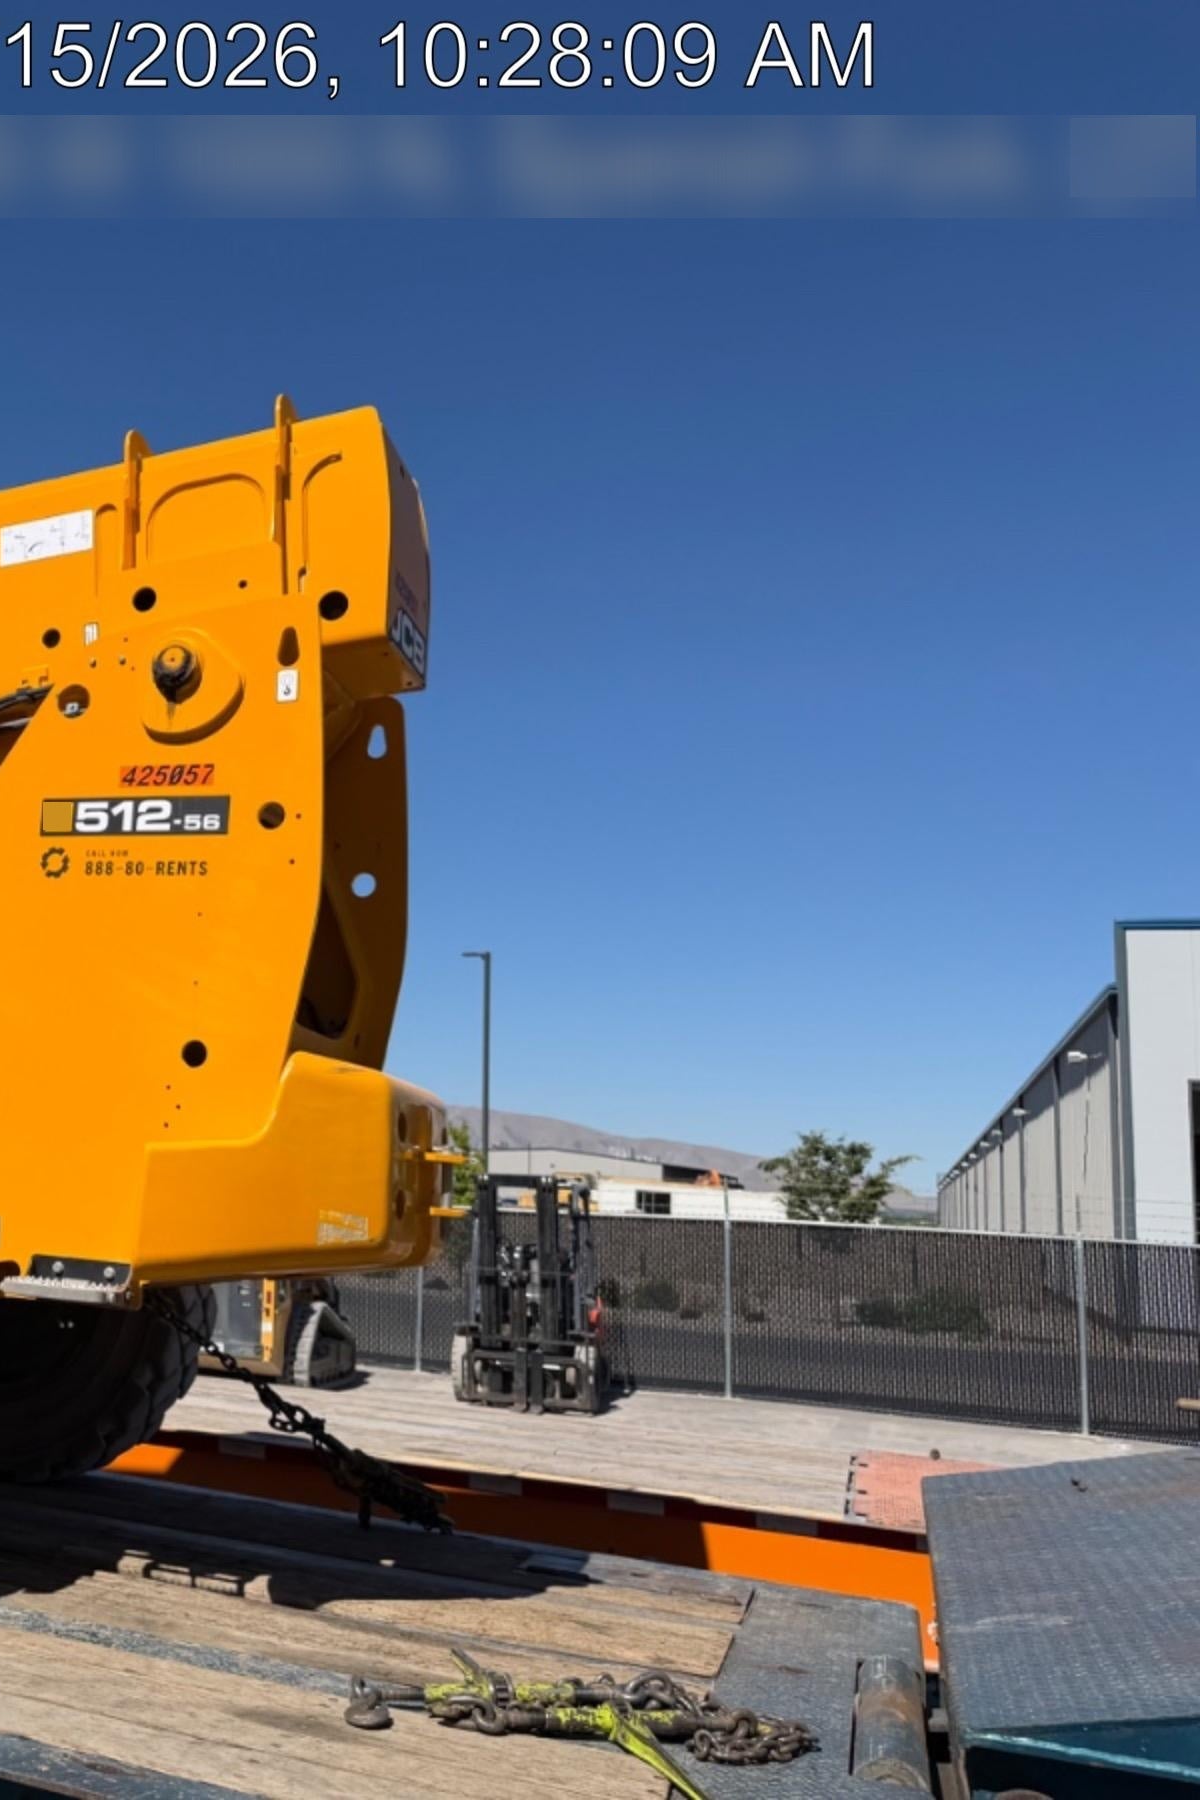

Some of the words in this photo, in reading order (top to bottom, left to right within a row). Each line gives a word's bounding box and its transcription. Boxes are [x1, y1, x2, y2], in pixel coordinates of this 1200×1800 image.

[391, 608, 425, 676] JCB
[121, 764, 215, 787] 425057
[74, 799, 221, 833] 512-56
